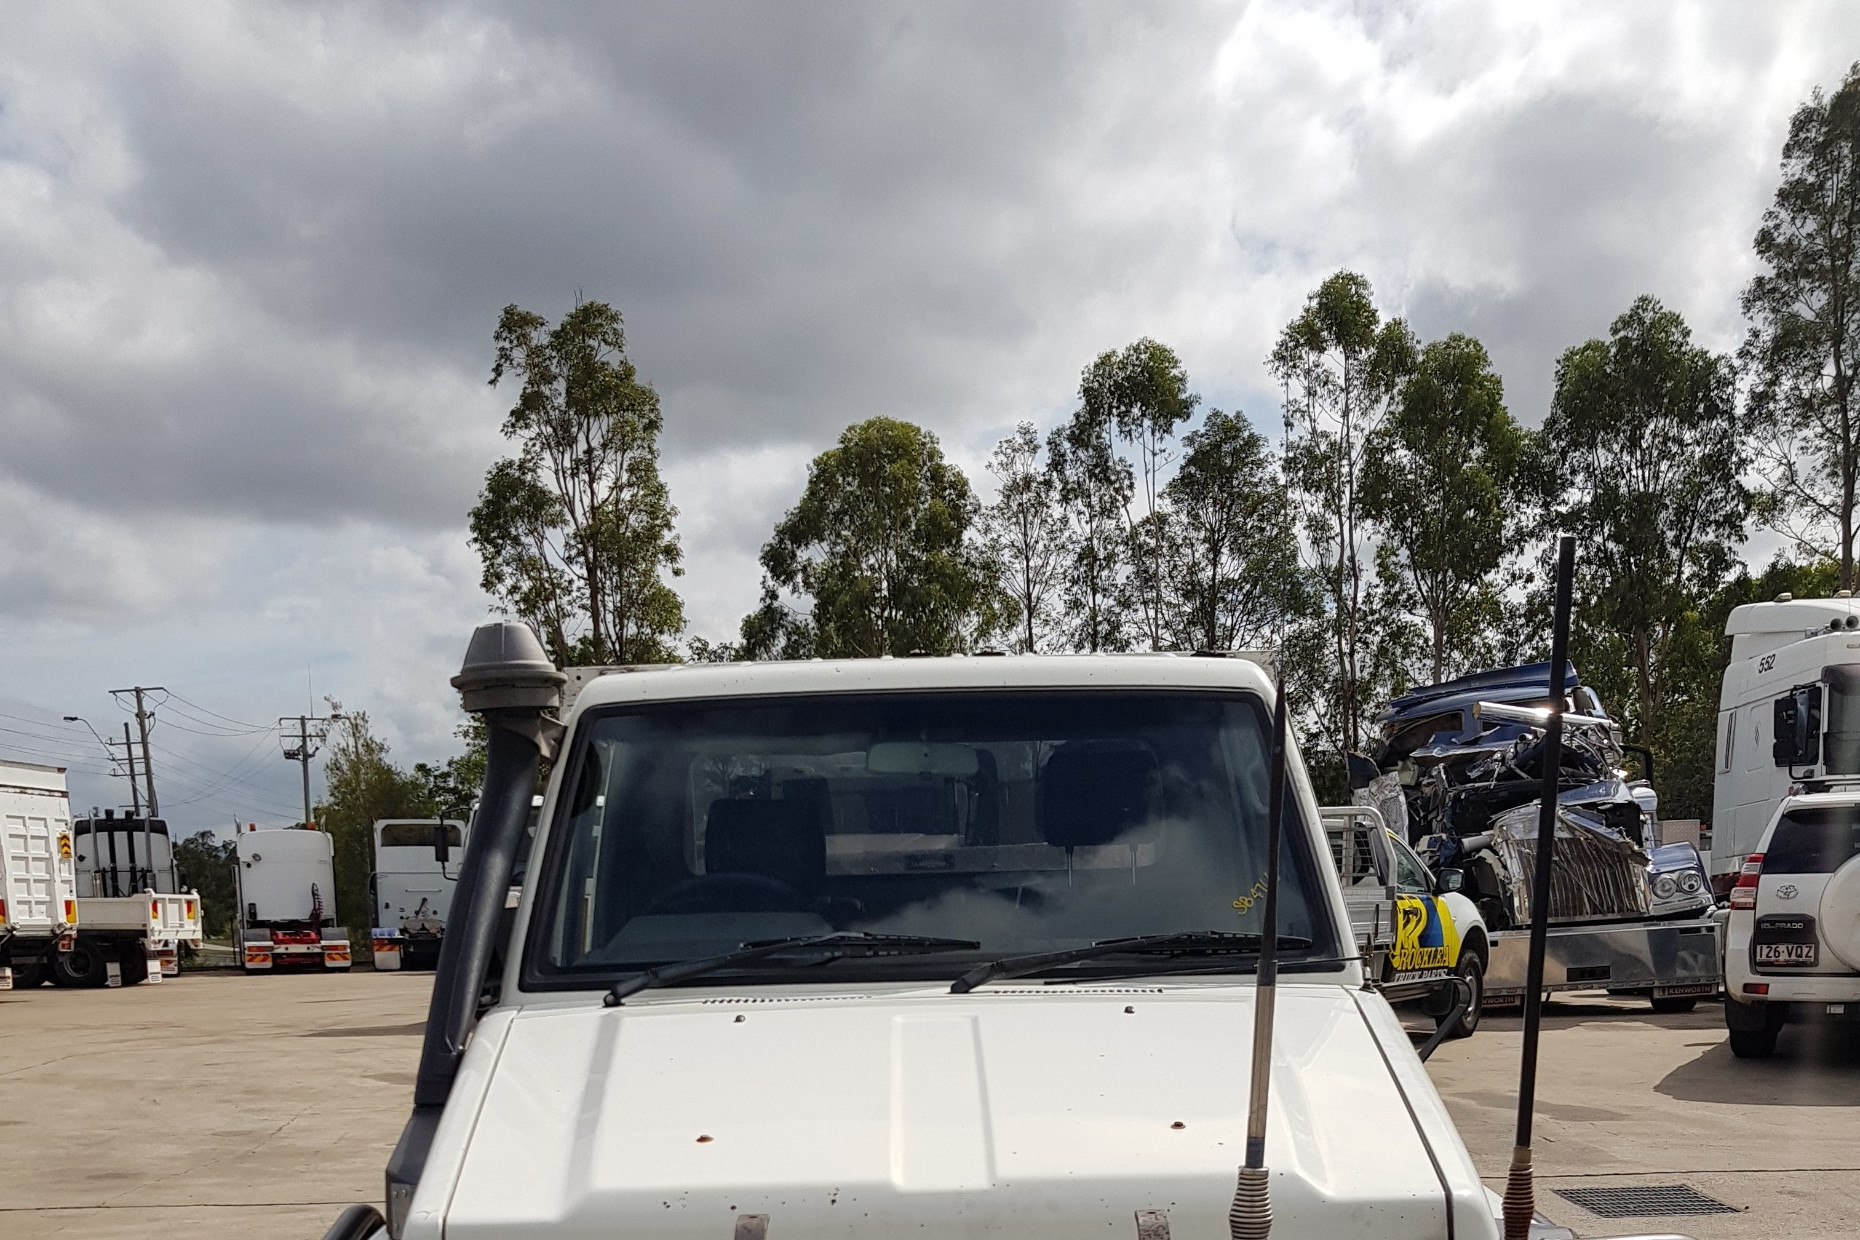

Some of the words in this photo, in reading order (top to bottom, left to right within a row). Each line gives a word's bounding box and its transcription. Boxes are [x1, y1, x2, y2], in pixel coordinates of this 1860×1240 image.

[1758, 653, 1776, 674] 552
[1397, 945, 1450, 971] ROCKLEA
[1394, 970, 1422, 983] TRUCK
[1422, 968, 1449, 979] PARTS
[1669, 985, 1711, 995] KENWORTH
